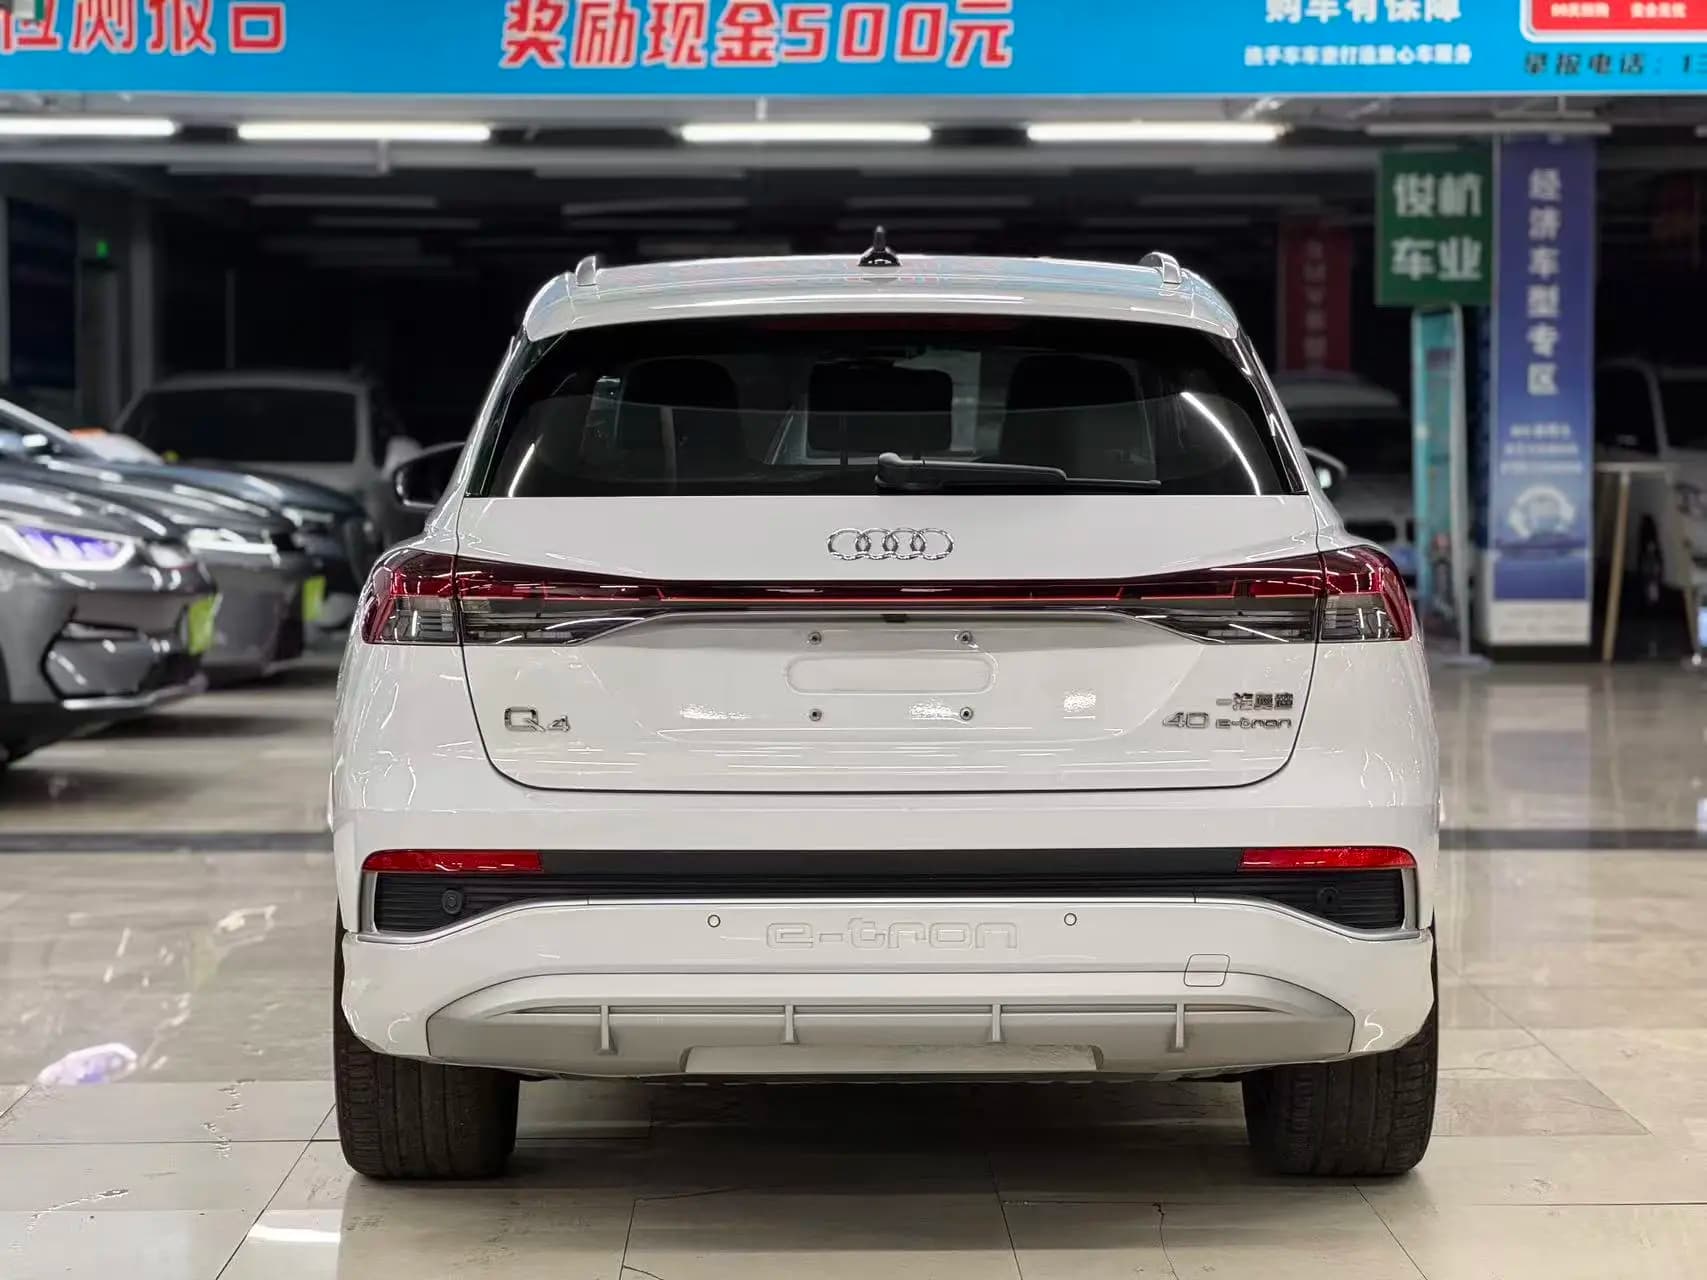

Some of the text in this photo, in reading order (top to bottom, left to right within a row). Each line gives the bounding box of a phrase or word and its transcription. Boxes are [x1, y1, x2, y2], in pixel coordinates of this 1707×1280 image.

[501, 0, 1012, 67] 奖励现金500元
[1391, 237, 1483, 281] 车业
[504, 706, 571, 732] Q4
[1162, 712, 1292, 729] 40 e-tron
[766, 917, 1018, 949] e-tron
